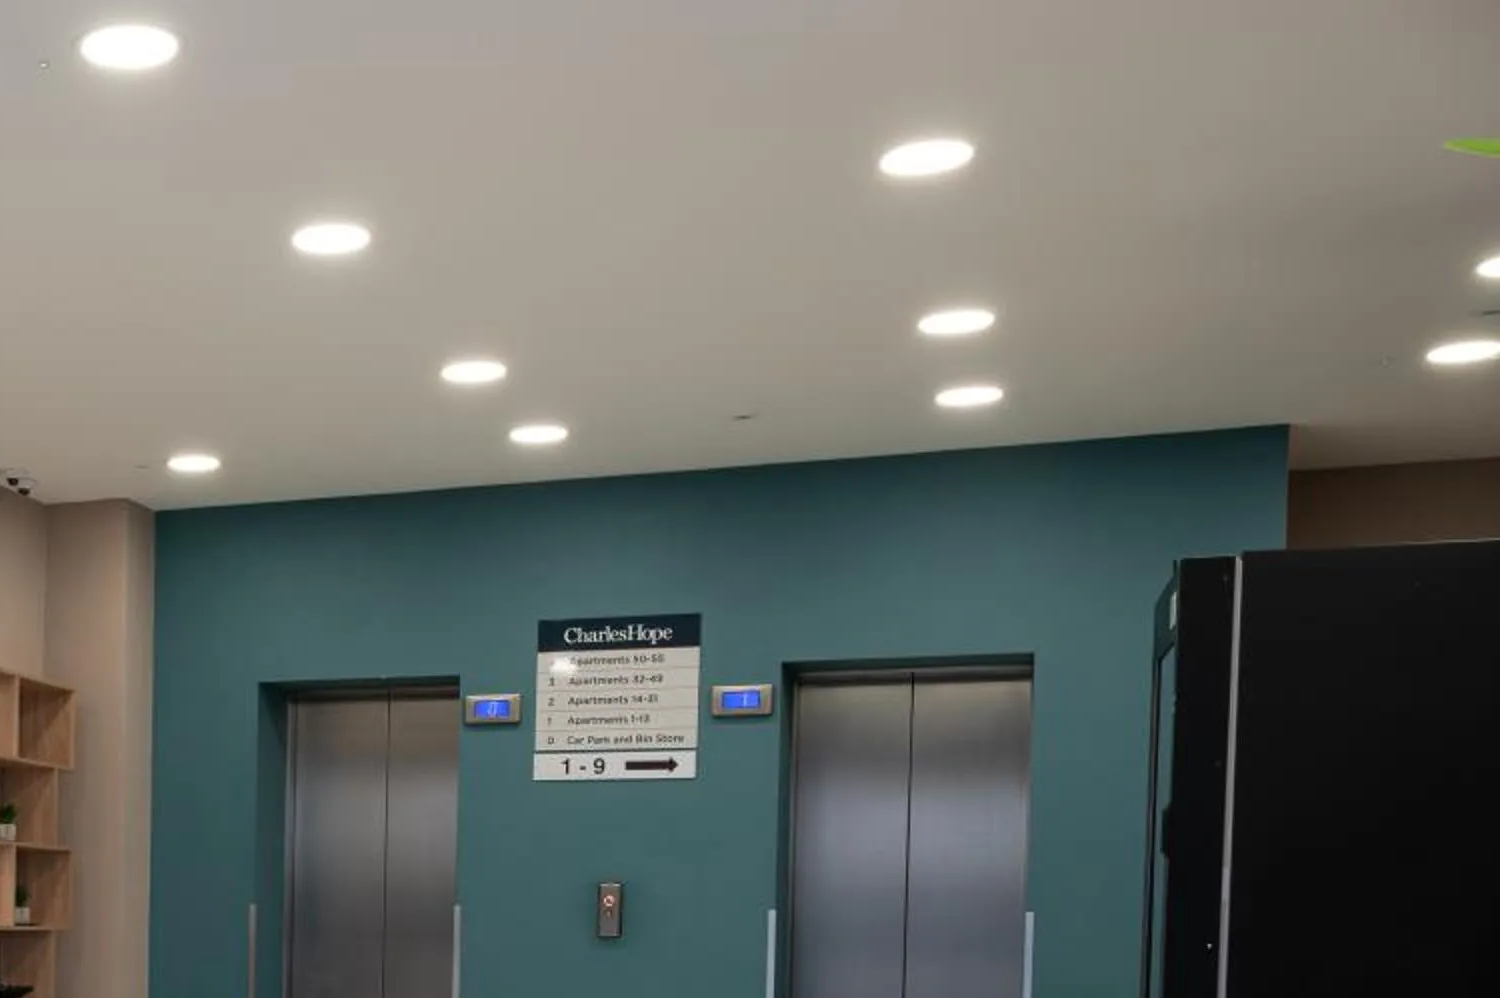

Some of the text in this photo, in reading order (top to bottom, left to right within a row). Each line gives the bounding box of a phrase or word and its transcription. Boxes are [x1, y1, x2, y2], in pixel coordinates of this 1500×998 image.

[563, 624, 673, 645] CharlesHope
[568, 675, 629, 687] Apartments
[547, 697, 555, 707] 2
[567, 695, 629, 707] Apartments
[567, 715, 628, 726] Apartments
[567, 735, 584, 745] Car
[587, 735, 611, 745] Park
[613, 734, 632, 744] and
[635, 733, 653, 744] Bin
[656, 733, 685, 744] Store
[560, 757, 571, 775] 1
[592, 757, 606, 775] 9
